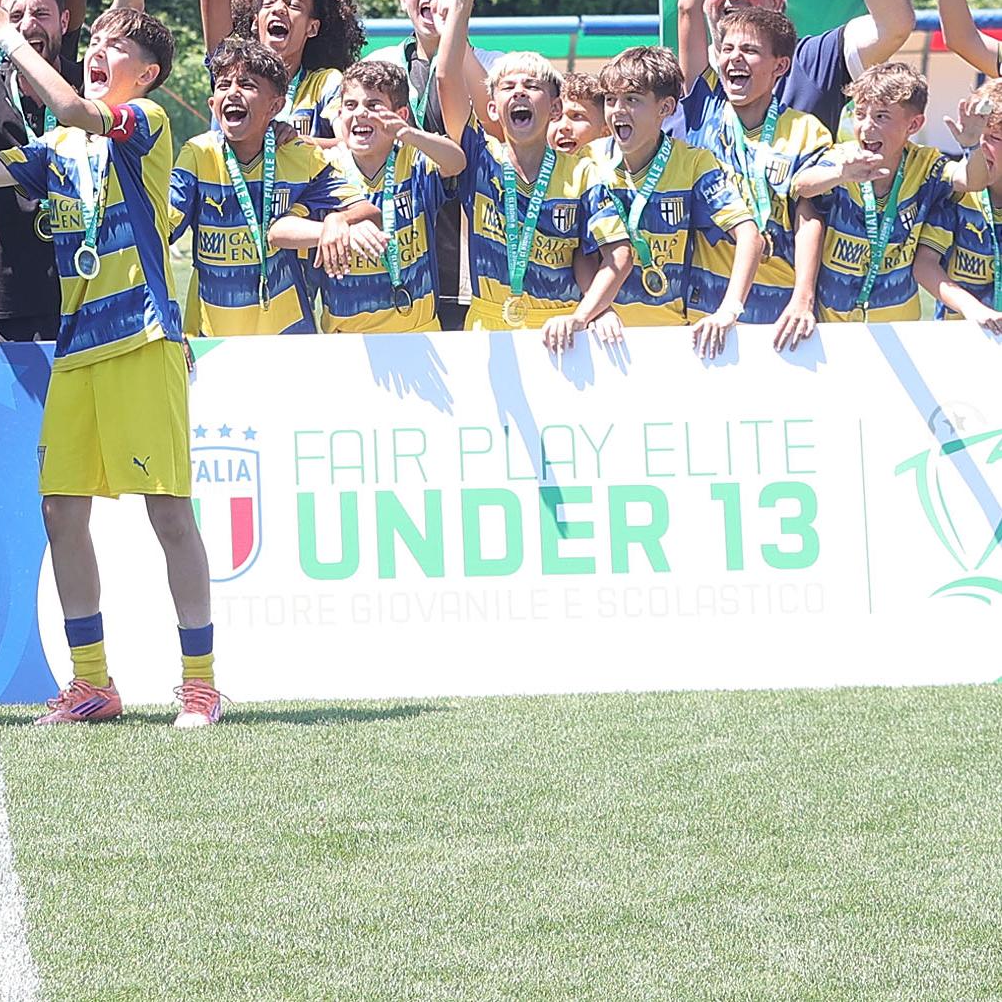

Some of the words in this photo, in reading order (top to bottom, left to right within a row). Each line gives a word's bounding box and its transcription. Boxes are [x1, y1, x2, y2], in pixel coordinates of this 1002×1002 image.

[265, 158, 275, 198] FINALE
[539, 152, 554, 187] FINALE
[640, 164, 663, 196] INALE
[527, 188, 544, 219] 2026
[191, 459, 252, 482] ALIA
[294, 427, 428, 485] FAIR
[459, 423, 614, 482] PLAY
[643, 419, 817, 476] ELITE
[296, 483, 672, 580] UNDER
[710, 480, 820, 571] 13
[211, 594, 336, 629] ETTORE
[352, 588, 549, 625] GIOVANILE
[564, 587, 583, 620] E
[597, 582, 826, 619] SCOLASTICO
